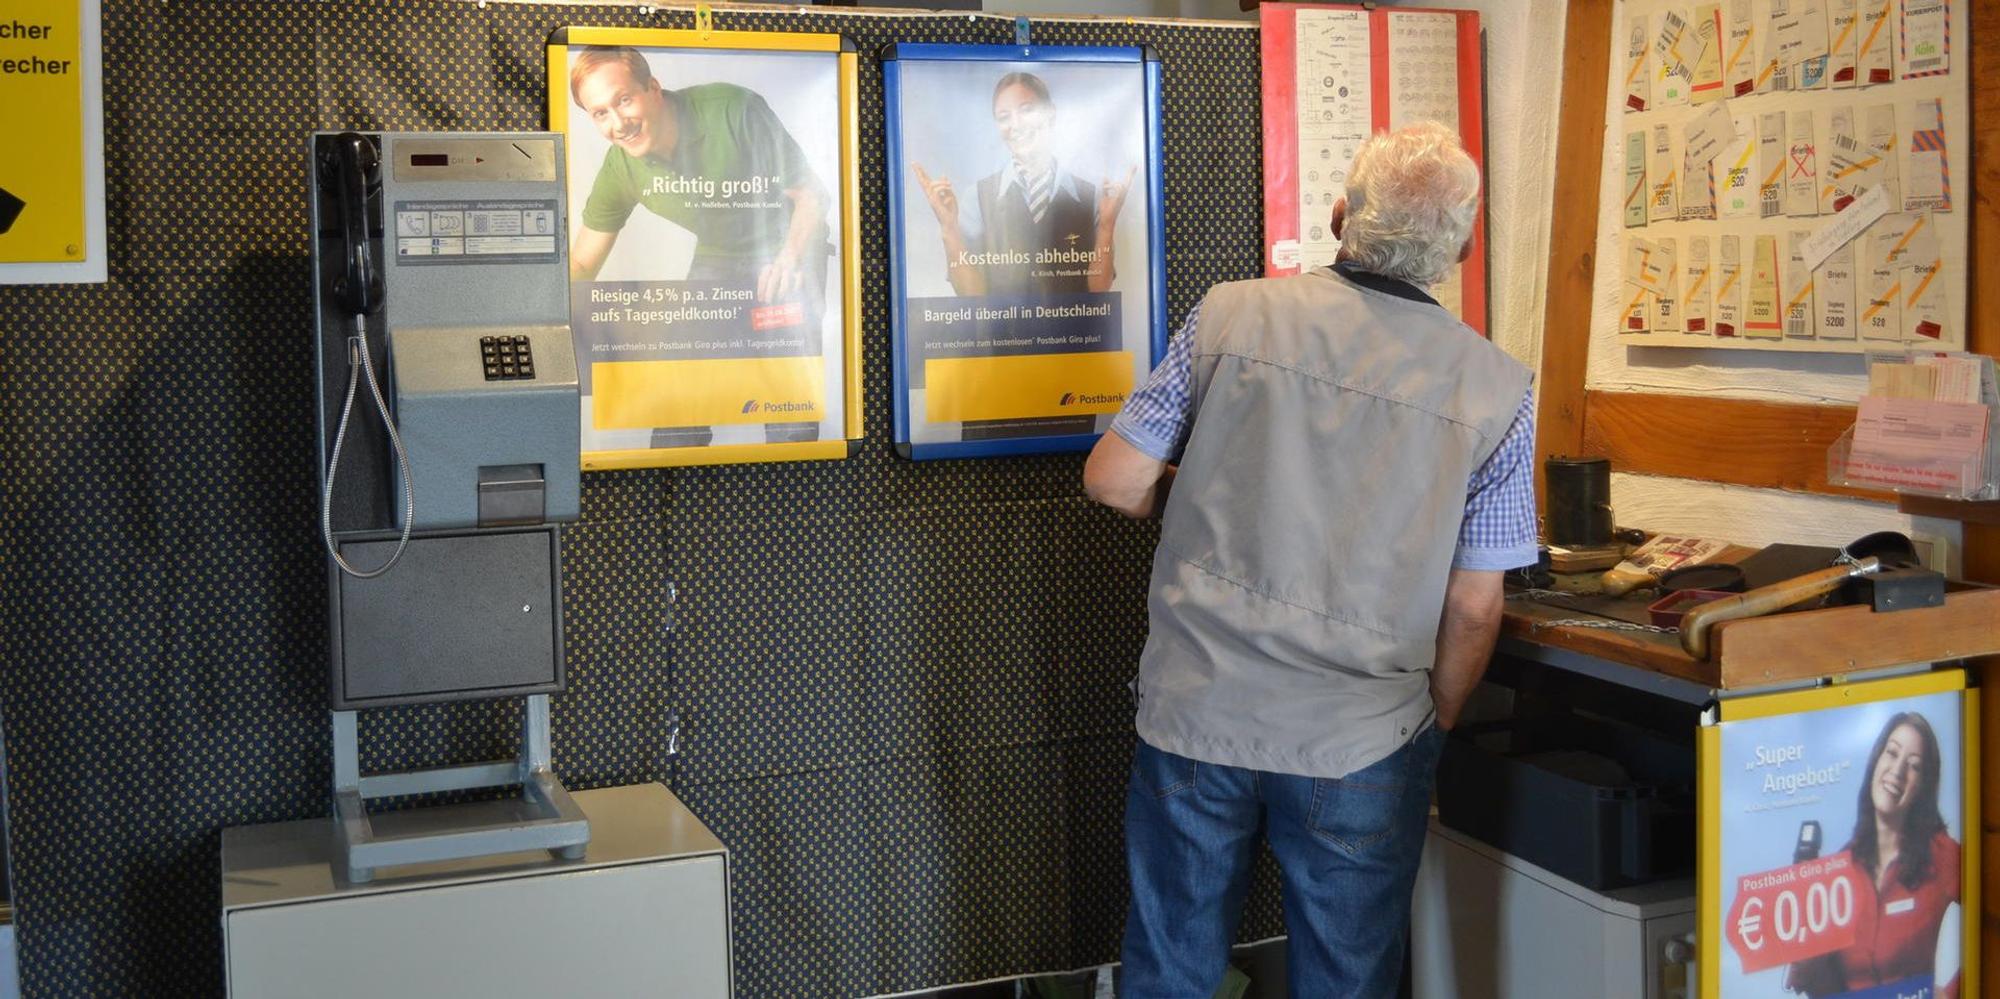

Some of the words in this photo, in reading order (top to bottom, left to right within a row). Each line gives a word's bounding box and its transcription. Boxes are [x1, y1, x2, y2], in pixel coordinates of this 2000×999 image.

[0, 55, 71, 75] echer
[643, 176, 715, 198] „Richtig
[721, 175, 780, 198] groß!“
[1731, 175, 1744, 188] 520
[1763, 189, 1778, 200] 520
[951, 248, 1030, 268] „Kostenlos
[1035, 246, 1110, 264] abheben!“
[1828, 270, 1848, 279] Briefe
[591, 289, 639, 305] Riesige
[712, 287, 754, 301] Zinsen
[591, 308, 621, 322] aufs
[925, 307, 972, 325] Bargeld
[975, 305, 1018, 321] überall
[1021, 306, 1032, 319] in
[1036, 303, 1112, 318] Deutschland!
[1754, 307, 1769, 317] 5200
[1791, 308, 1805, 319] 520
[1825, 316, 1846, 328] 5200
[1872, 316, 1886, 328] 520
[591, 343, 610, 352] Jetzt
[611, 342, 646, 351] wechseln
[659, 341, 692, 350] Postbank
[694, 340, 711, 349] Giro
[924, 339, 941, 350] Jetzt
[976, 340, 991, 348] zum
[1037, 335, 1067, 345] Postbank
[1069, 335, 1083, 344] Giro
[1080, 392, 1125, 405] Postbank
[764, 400, 814, 413] Postbank
[1745, 744, 1805, 770] „Super
[1763, 760, 1851, 795] Angebot!“
[1743, 869, 1796, 892] Postbank
[1799, 863, 1822, 879] Giro
[1823, 858, 1849, 875] plus
[1737, 895, 1764, 951] €
[1774, 874, 1853, 943] 0,00
